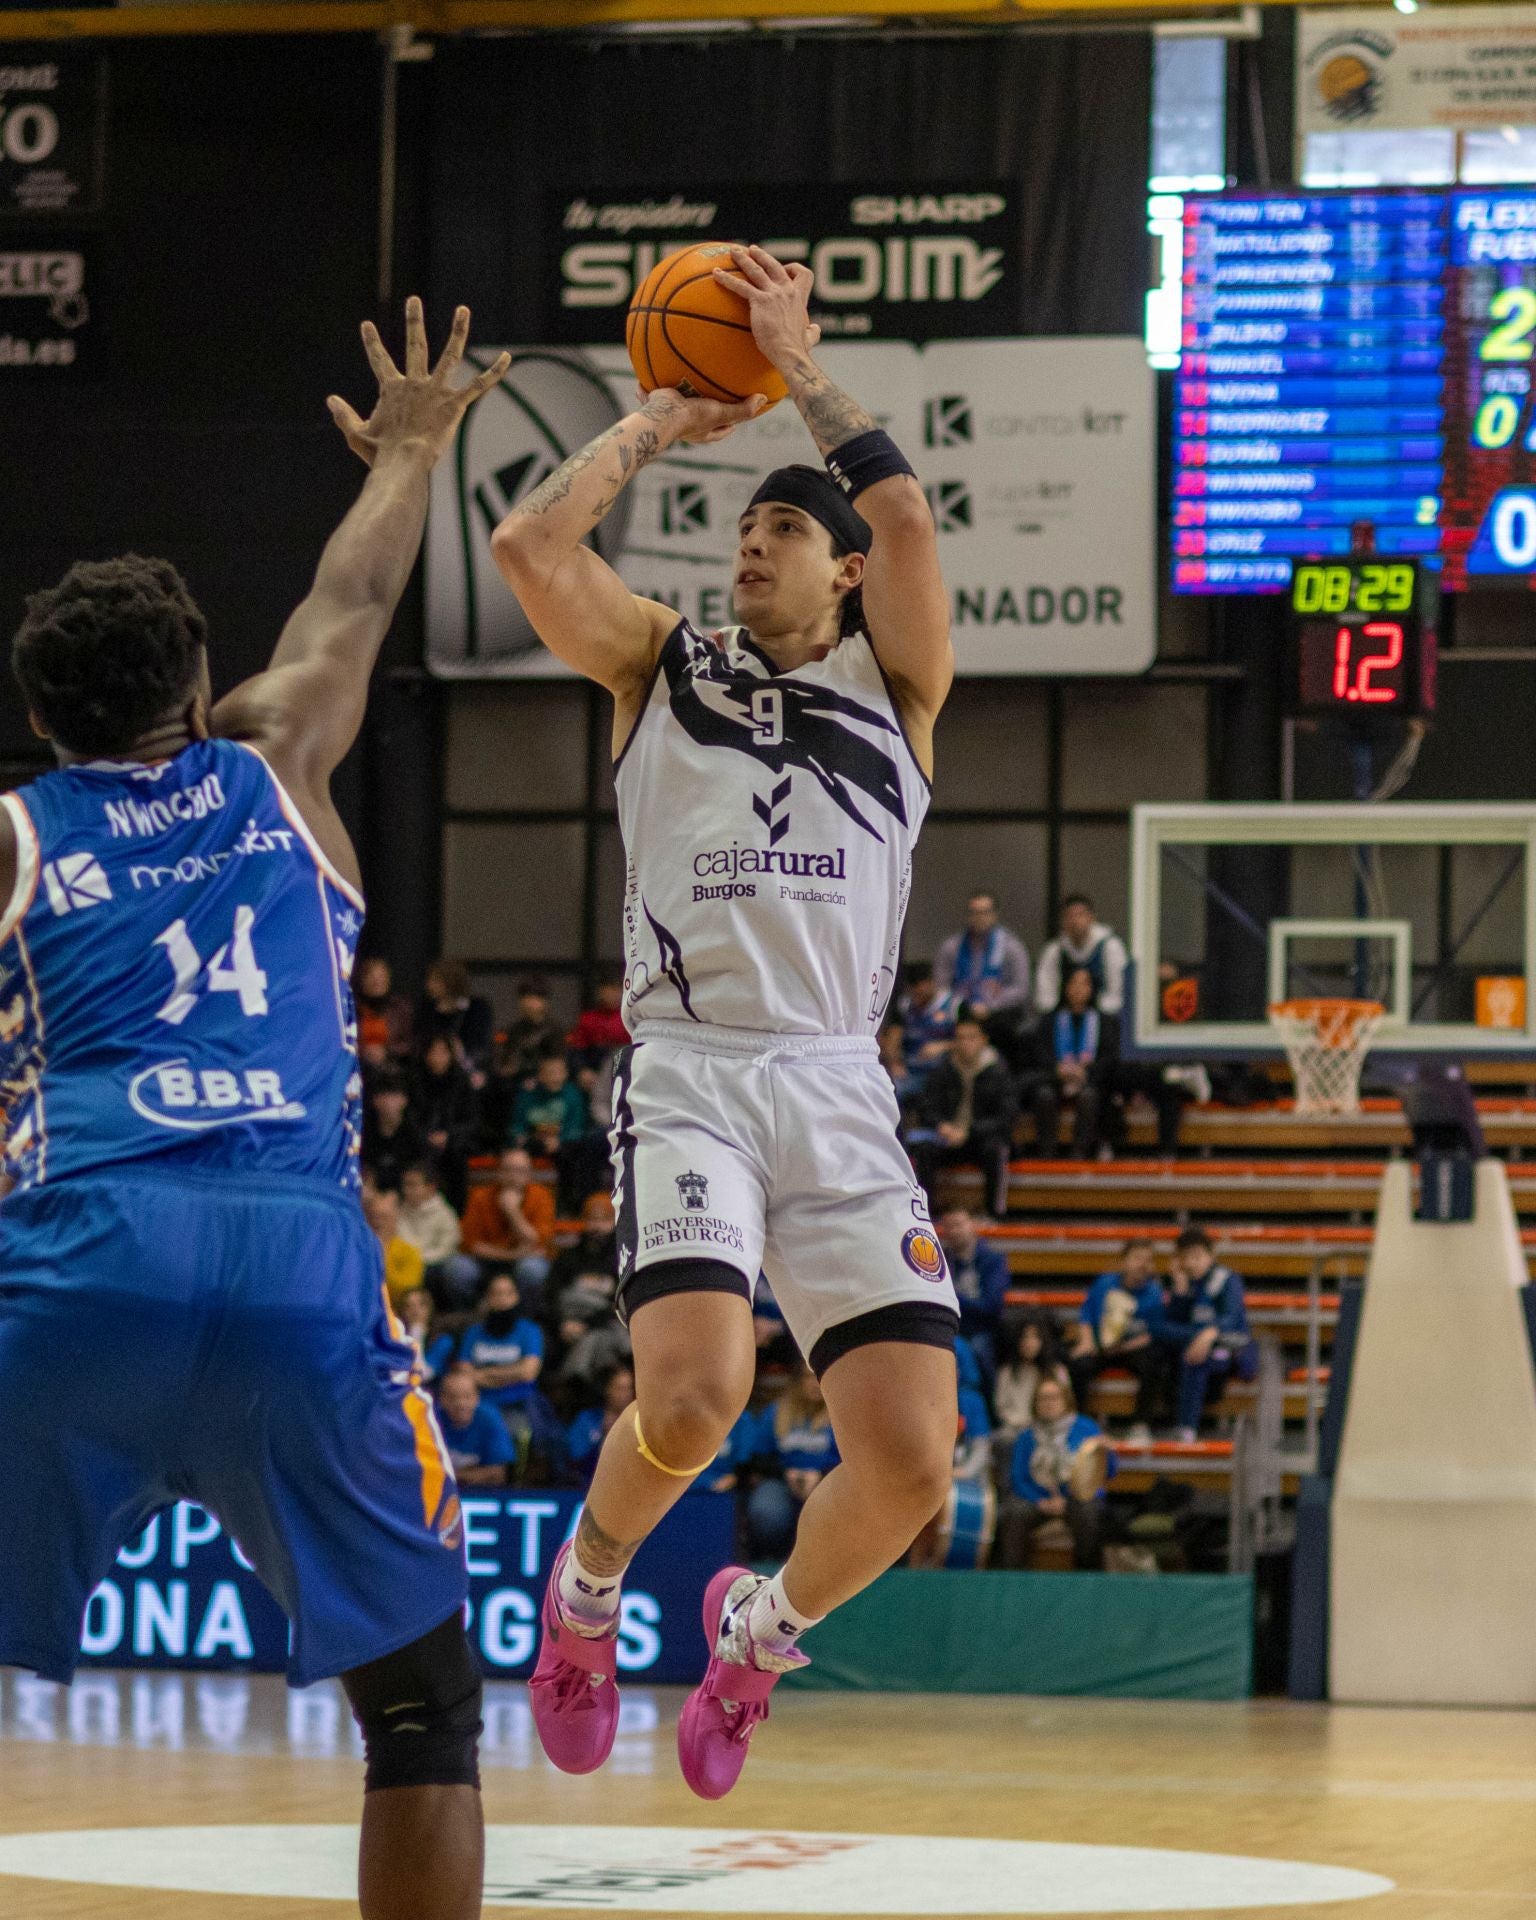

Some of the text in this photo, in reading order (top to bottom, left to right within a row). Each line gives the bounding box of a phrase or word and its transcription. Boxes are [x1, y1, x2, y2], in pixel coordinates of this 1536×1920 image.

[851, 193, 1006, 225] SHARP
[1475, 395, 1521, 448] 0
[954, 585, 1124, 626] NADOR
[1332, 622, 1404, 703] 1.2
[751, 688, 783, 746] 9
[693, 841, 847, 880] cajarural
[692, 883, 847, 906] Burgos Fundación
[643, 1216, 743, 1240] UNIVERSIDAD
[645, 1227, 745, 1253] DE BURGOS
[80, 1576, 255, 1660] ONA
